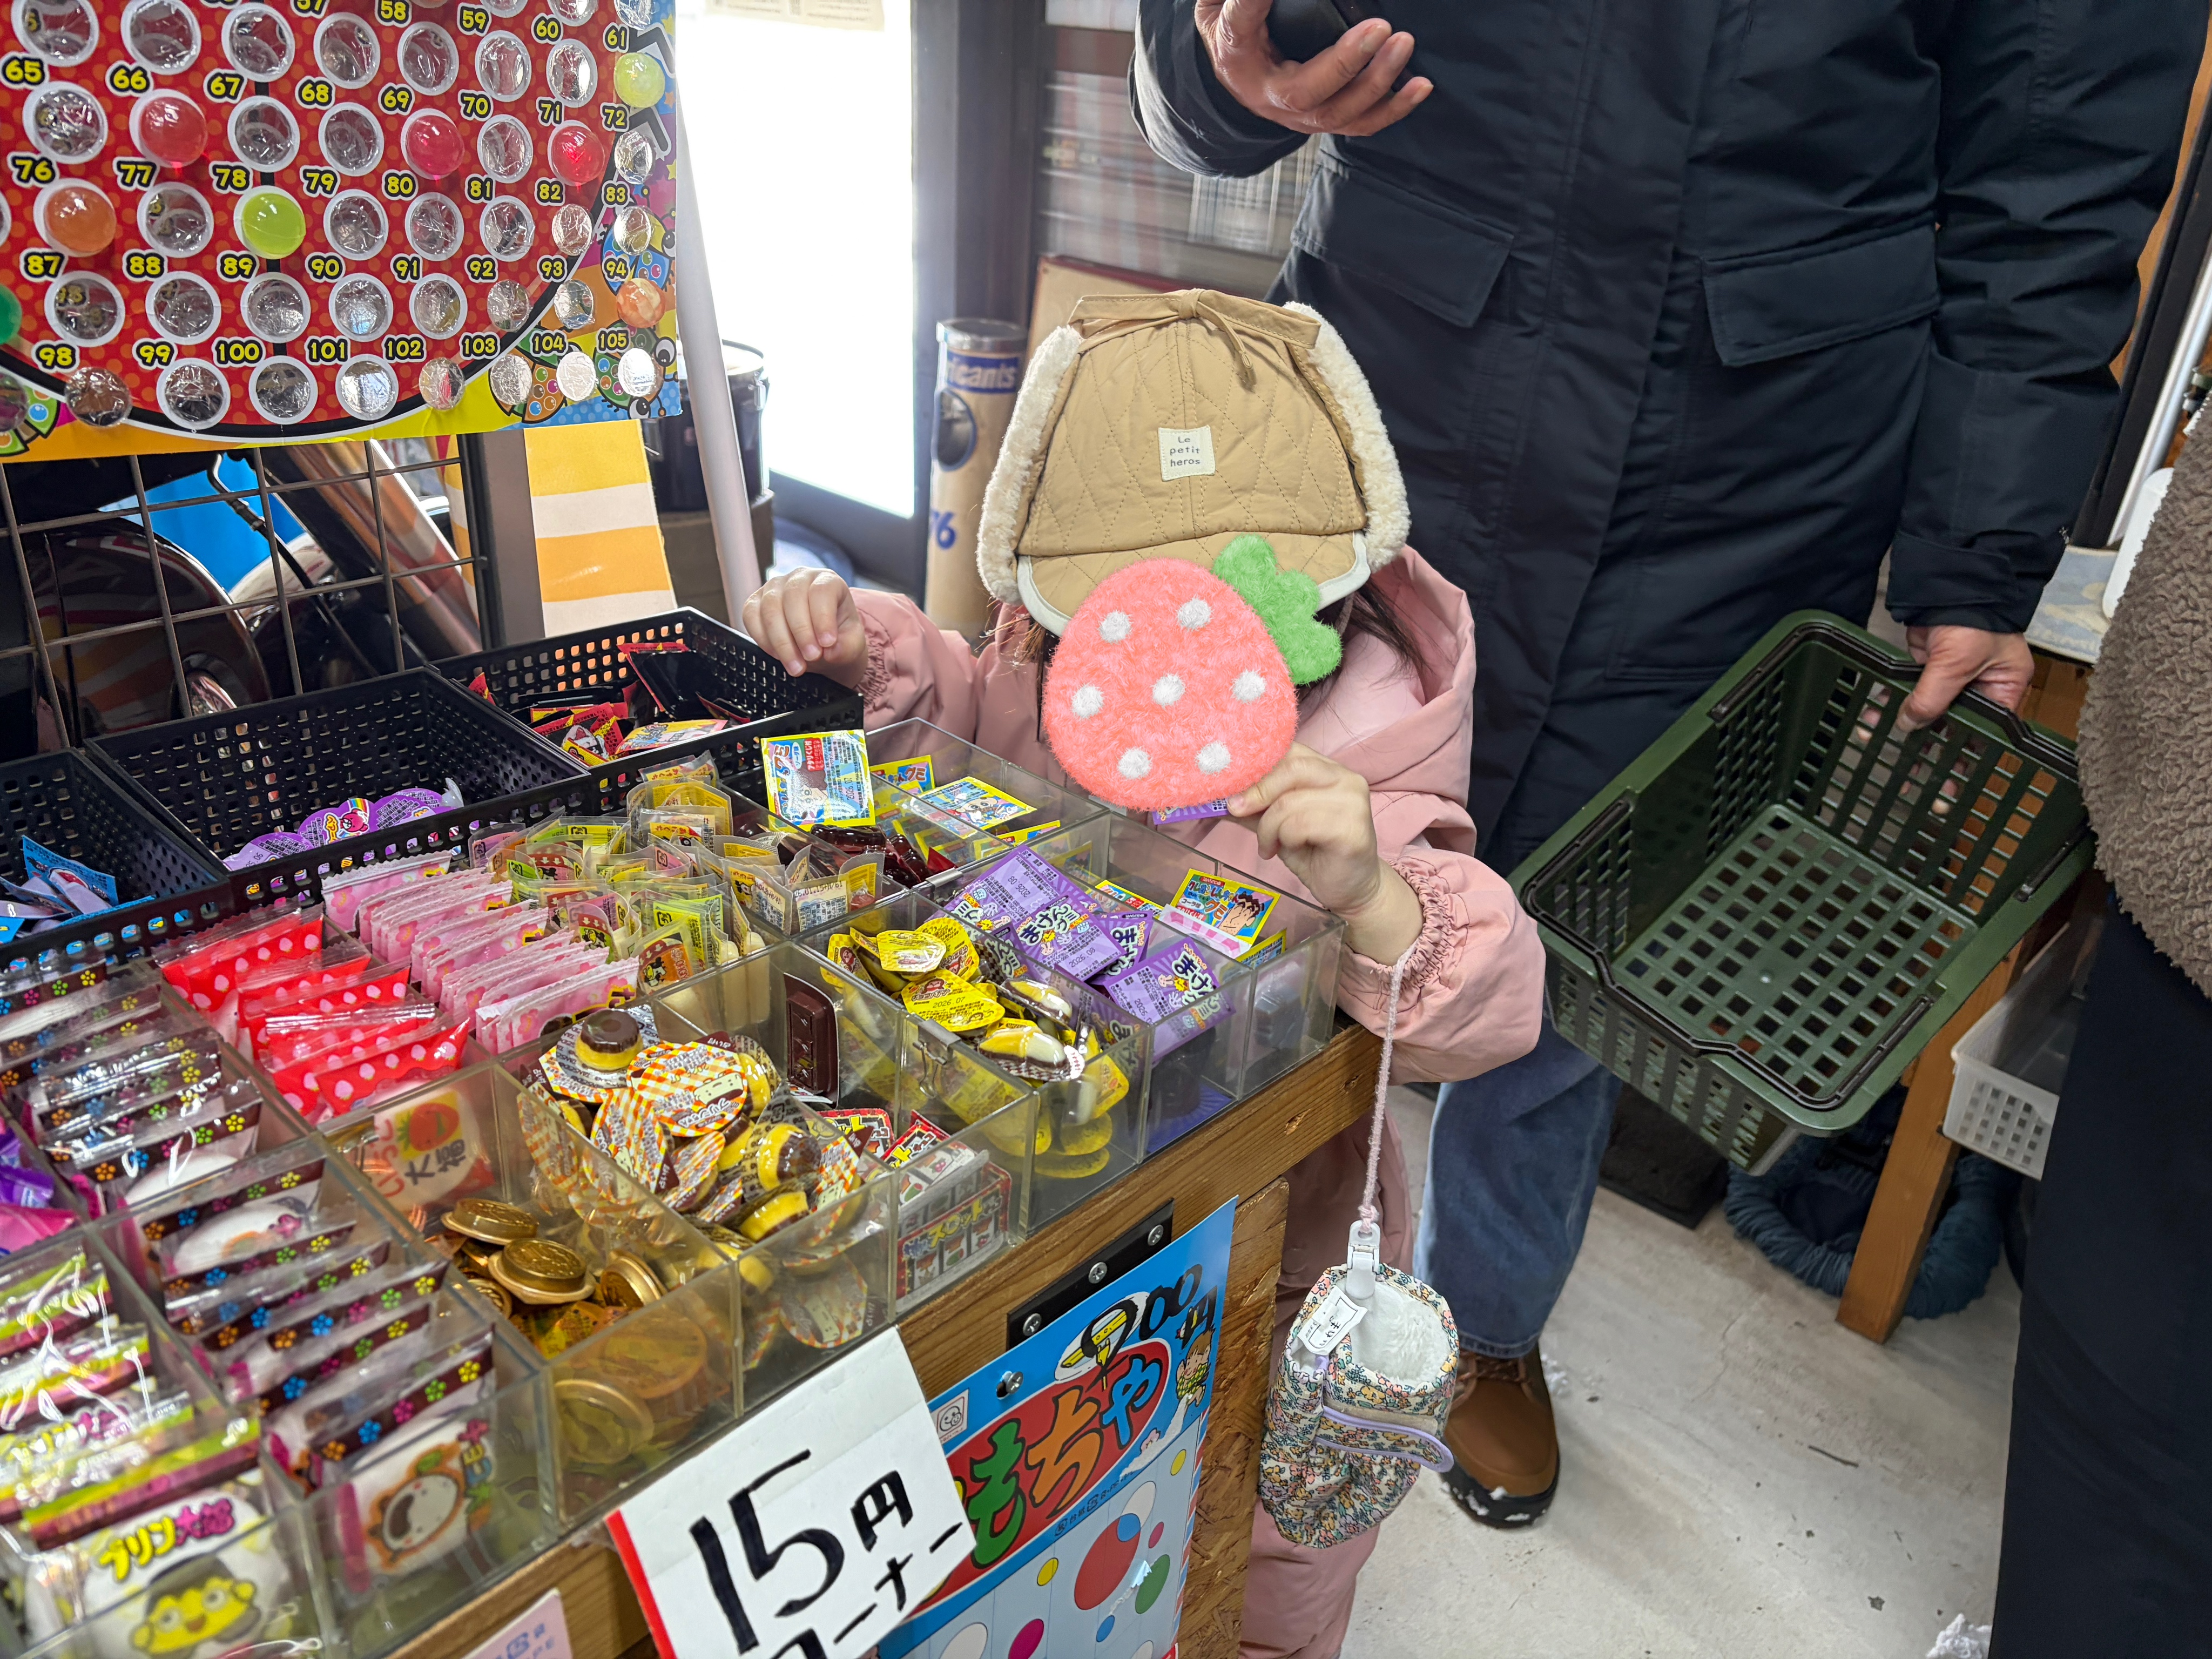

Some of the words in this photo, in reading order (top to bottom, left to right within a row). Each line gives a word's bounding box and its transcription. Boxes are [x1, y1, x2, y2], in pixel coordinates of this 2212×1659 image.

[381, 1, 407, 21] 58
[463, 10, 487, 30] 59
[536, 21, 559, 39] 60
[606, 30, 628, 48] 61
[5, 59, 42, 83] 65
[113, 68, 147, 90] 66
[210, 76, 241, 97] 67
[301, 83, 329, 103] 68
[384, 90, 410, 109] 69
[464, 97, 489, 116] 70
[541, 104, 561, 120] 71
[604, 108, 626, 126] 72
[15, 159, 52, 181] 76
[120, 164, 152, 184] 77
[216, 167, 247, 188] 78
[307, 173, 335, 192] 79
[388, 176, 414, 195] 80
[470, 180, 491, 198] 81
[539, 184, 562, 201] 82
[606, 187, 626, 203] 83
[27, 254, 60, 275] 87
[130, 255, 161, 275] 88
[224, 257, 254, 276] 89
[312, 259, 340, 277] 90
[396, 260, 419, 278] 91
[470, 260, 494, 277] 92
[542, 261, 563, 277] 93
[606, 261, 626, 277] 94
[388, 340, 422, 358] 102
[463, 338, 496, 355] 103
[534, 335, 564, 352] 104
[598, 331, 628, 348] 105
[38, 346, 73, 367] 98
[139, 344, 171, 363] 99
[219, 343, 260, 362] 100
[311, 342, 347, 360] 101
[1170, 446, 1201, 456] petit
[1170, 458, 1201, 467] heros
[1008, 876, 1031, 898] 2026.08
[1204, 899, 1229, 921] グミ
[1069, 947, 1096, 968] 2026.08
[933, 996, 966, 1008] 2026.07
[959, 1352, 1163, 1569] もちゃ
[689, 1449, 913, 1656] 15円
